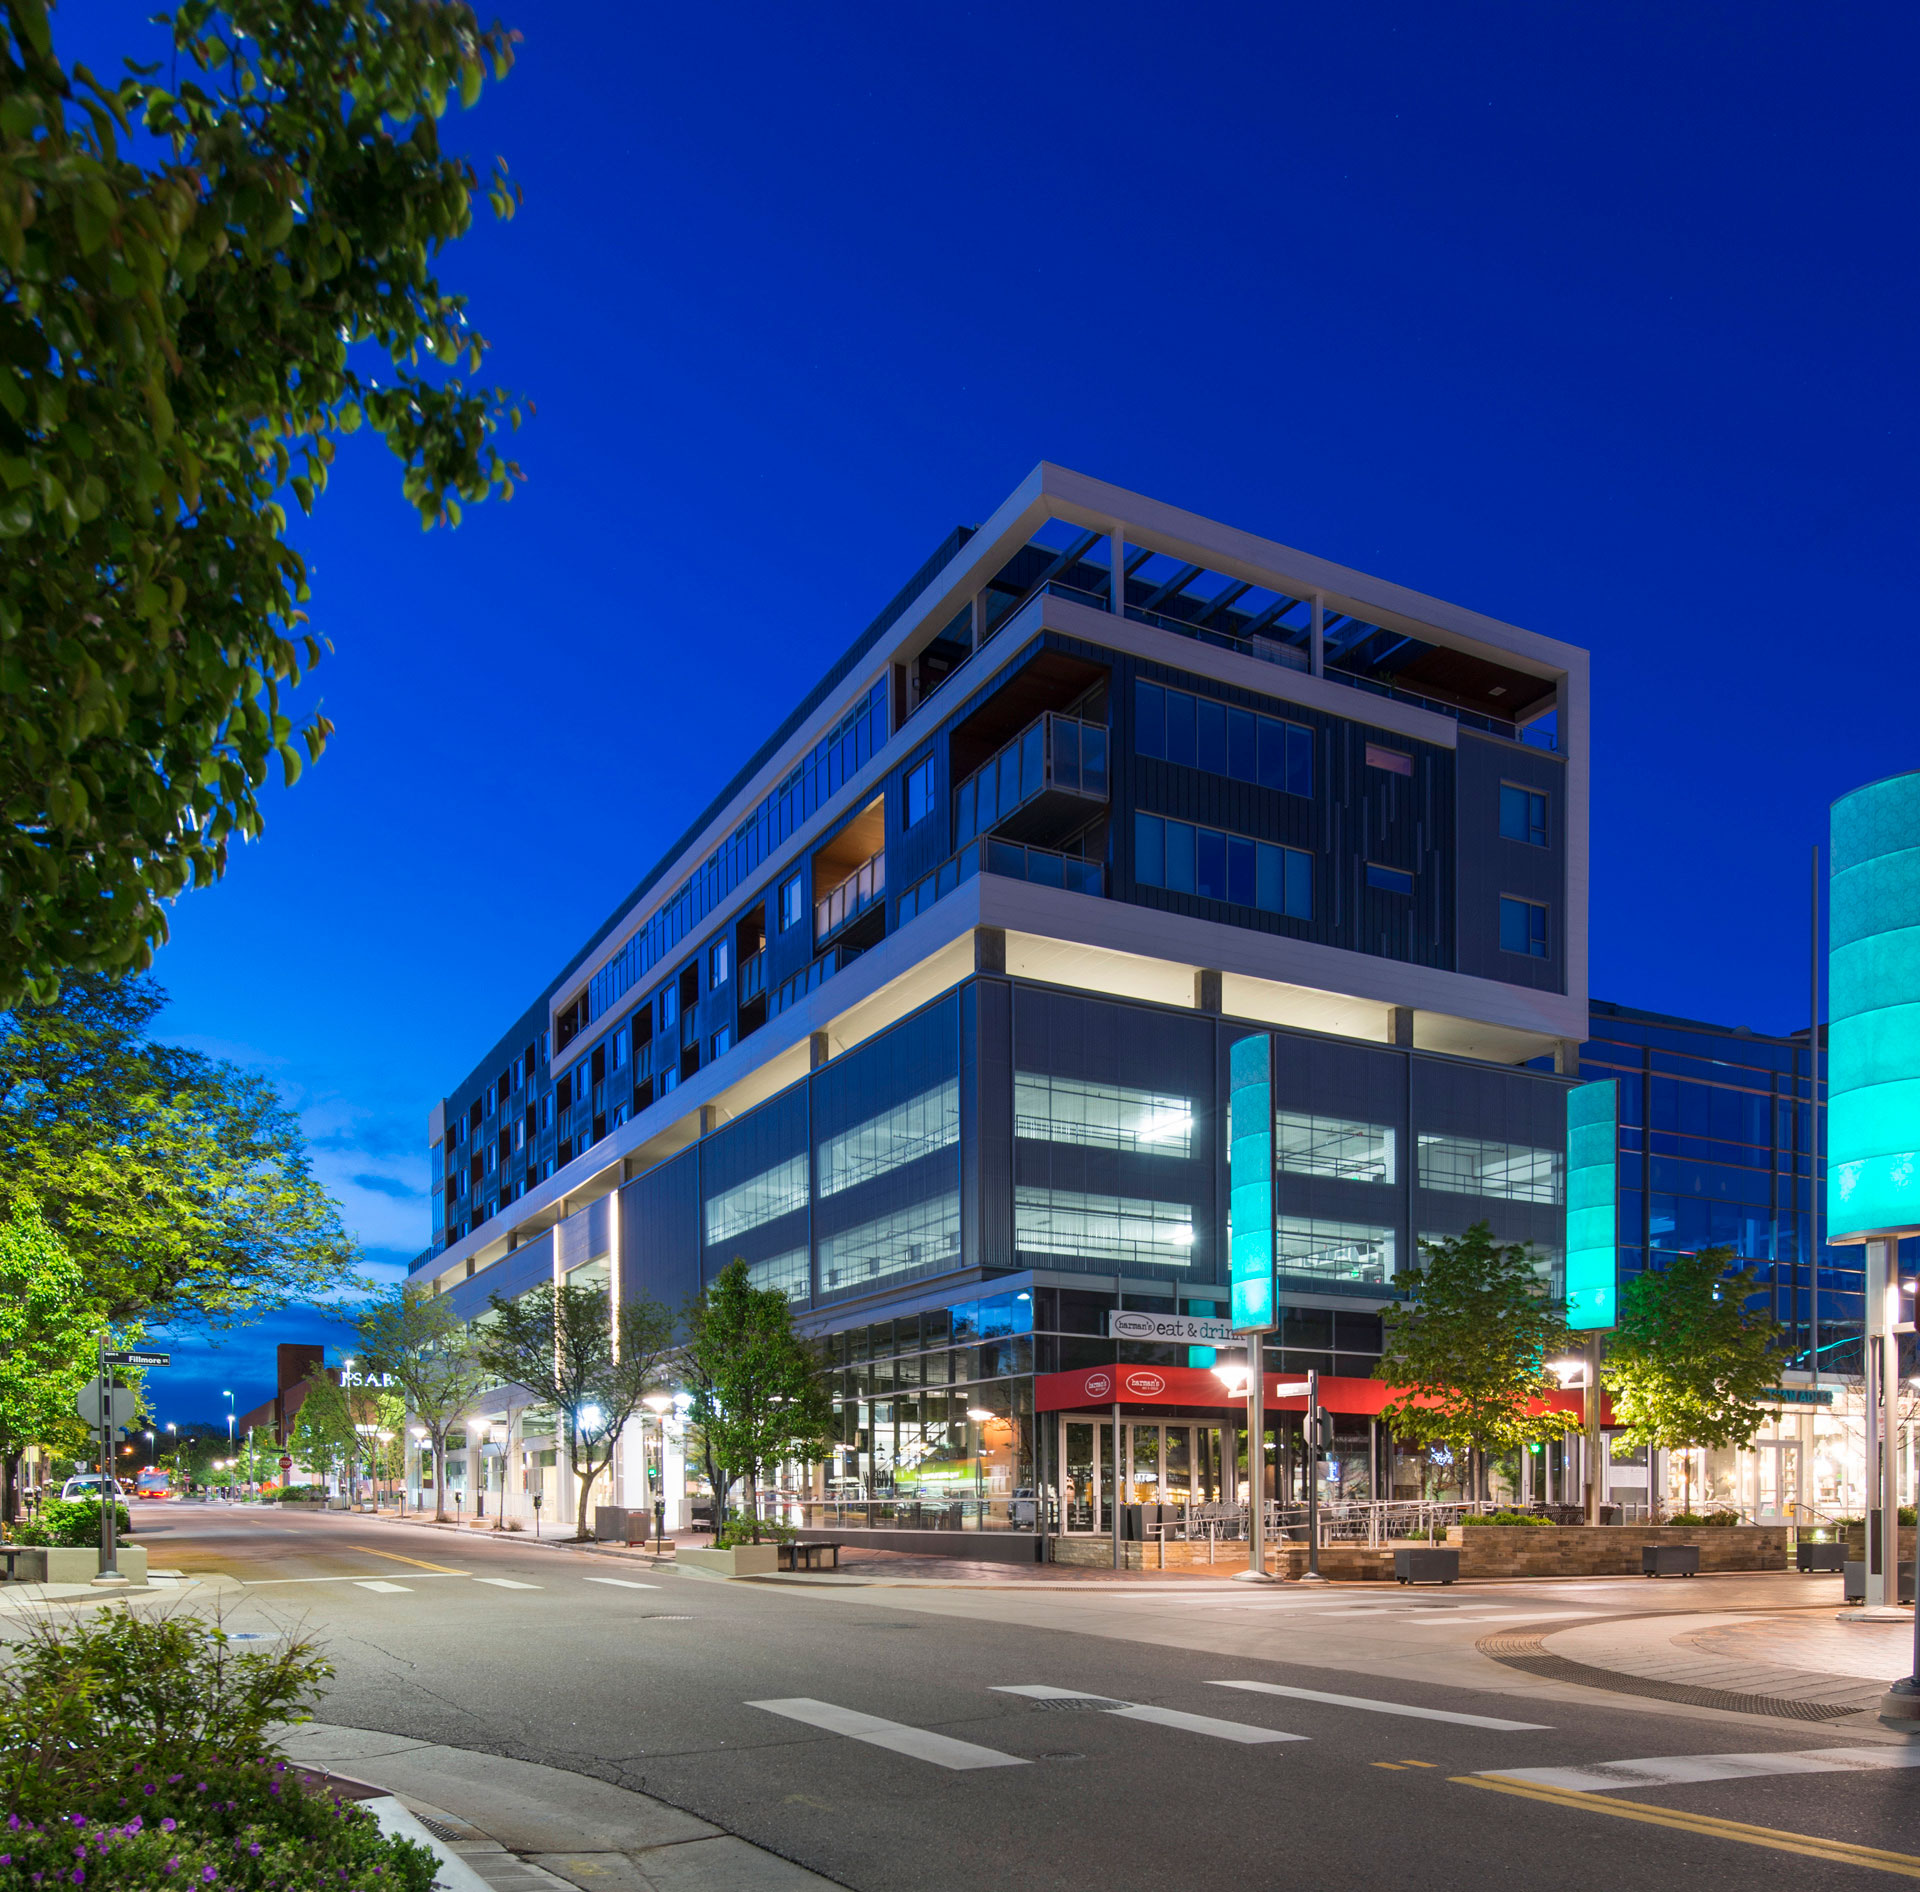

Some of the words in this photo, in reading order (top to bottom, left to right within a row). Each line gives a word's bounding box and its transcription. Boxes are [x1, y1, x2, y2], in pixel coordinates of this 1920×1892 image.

[1118, 1321, 1152, 1331] harman's
[1156, 1320, 1184, 1337] eat
[1187, 1322, 1197, 1338] &
[128, 1355, 161, 1364] Fillmore
[1131, 1378, 1160, 1387] harman's
[279, 1459, 292, 1467] STOP
